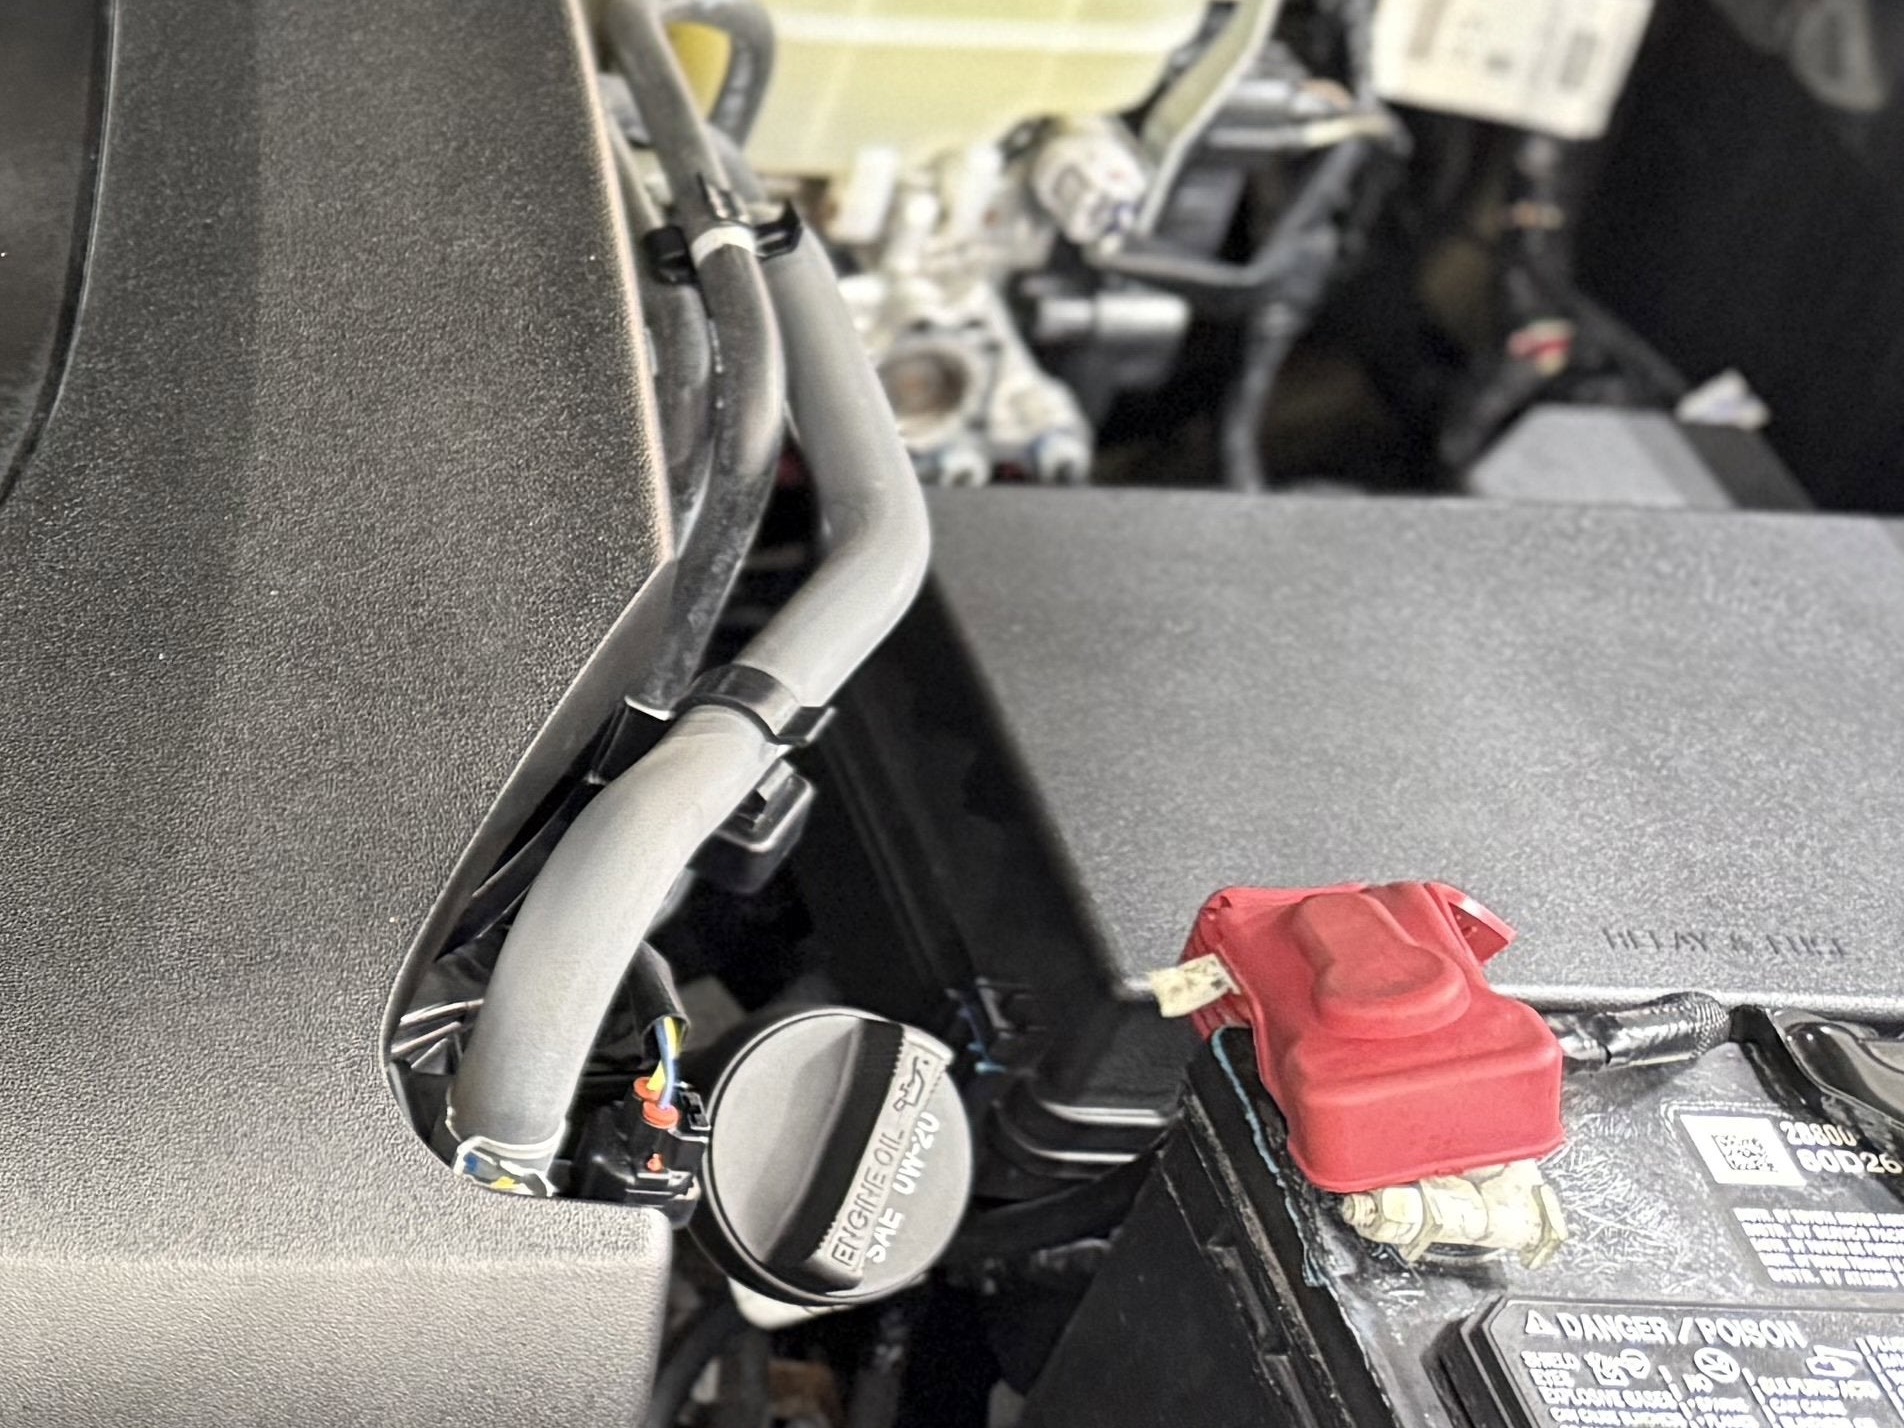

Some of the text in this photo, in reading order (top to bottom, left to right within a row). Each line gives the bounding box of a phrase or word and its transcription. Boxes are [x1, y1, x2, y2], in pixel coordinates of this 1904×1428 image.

[830, 1128, 906, 1267] ENGINE OIL
[865, 1207, 906, 1264] SAE
[1555, 1312, 1678, 1344] DANGER
[1694, 1316, 1808, 1348] POISON
